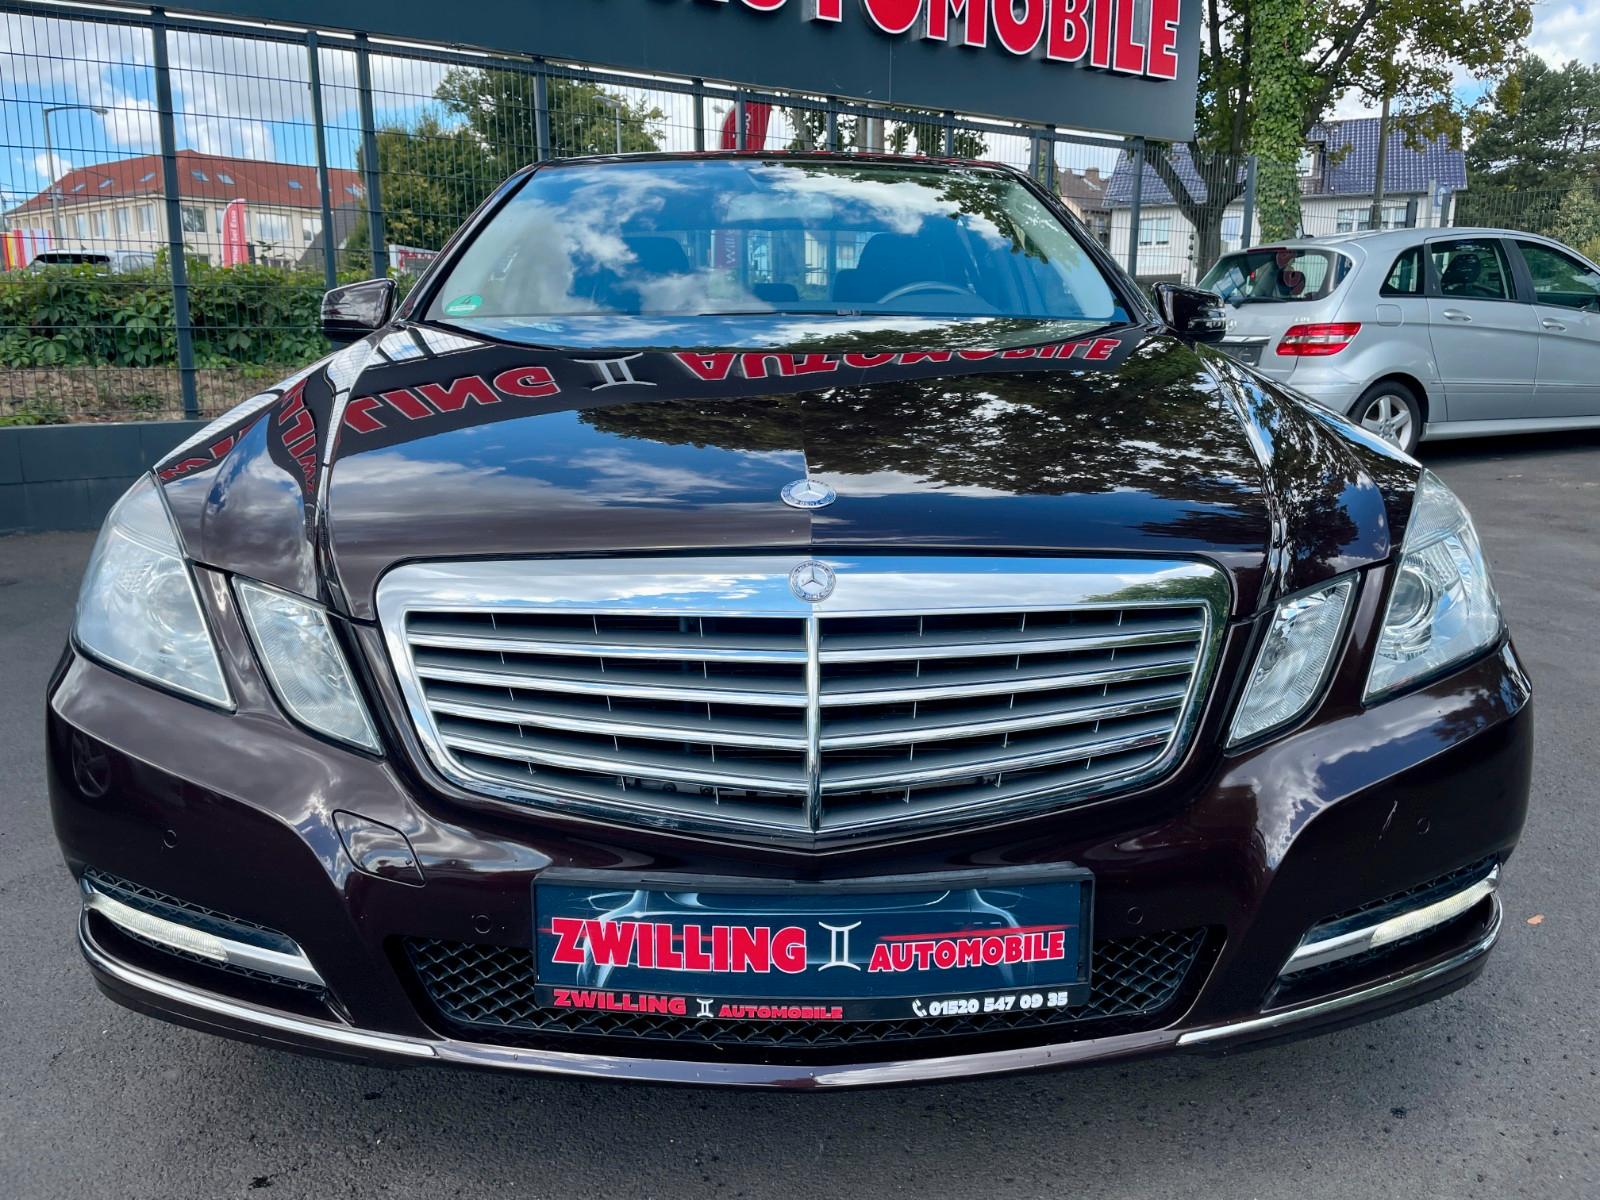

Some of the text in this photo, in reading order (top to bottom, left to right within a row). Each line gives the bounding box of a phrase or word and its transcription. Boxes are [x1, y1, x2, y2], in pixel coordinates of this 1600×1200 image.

[712, 0, 1182, 80] MOBILE
[552, 917, 1066, 975] ZWILLING AUTOMOBILE
[553, 989, 844, 1020] ZWILLING AUTOMOBILE
[928, 991, 1069, 1016] 01520 547 09 35
